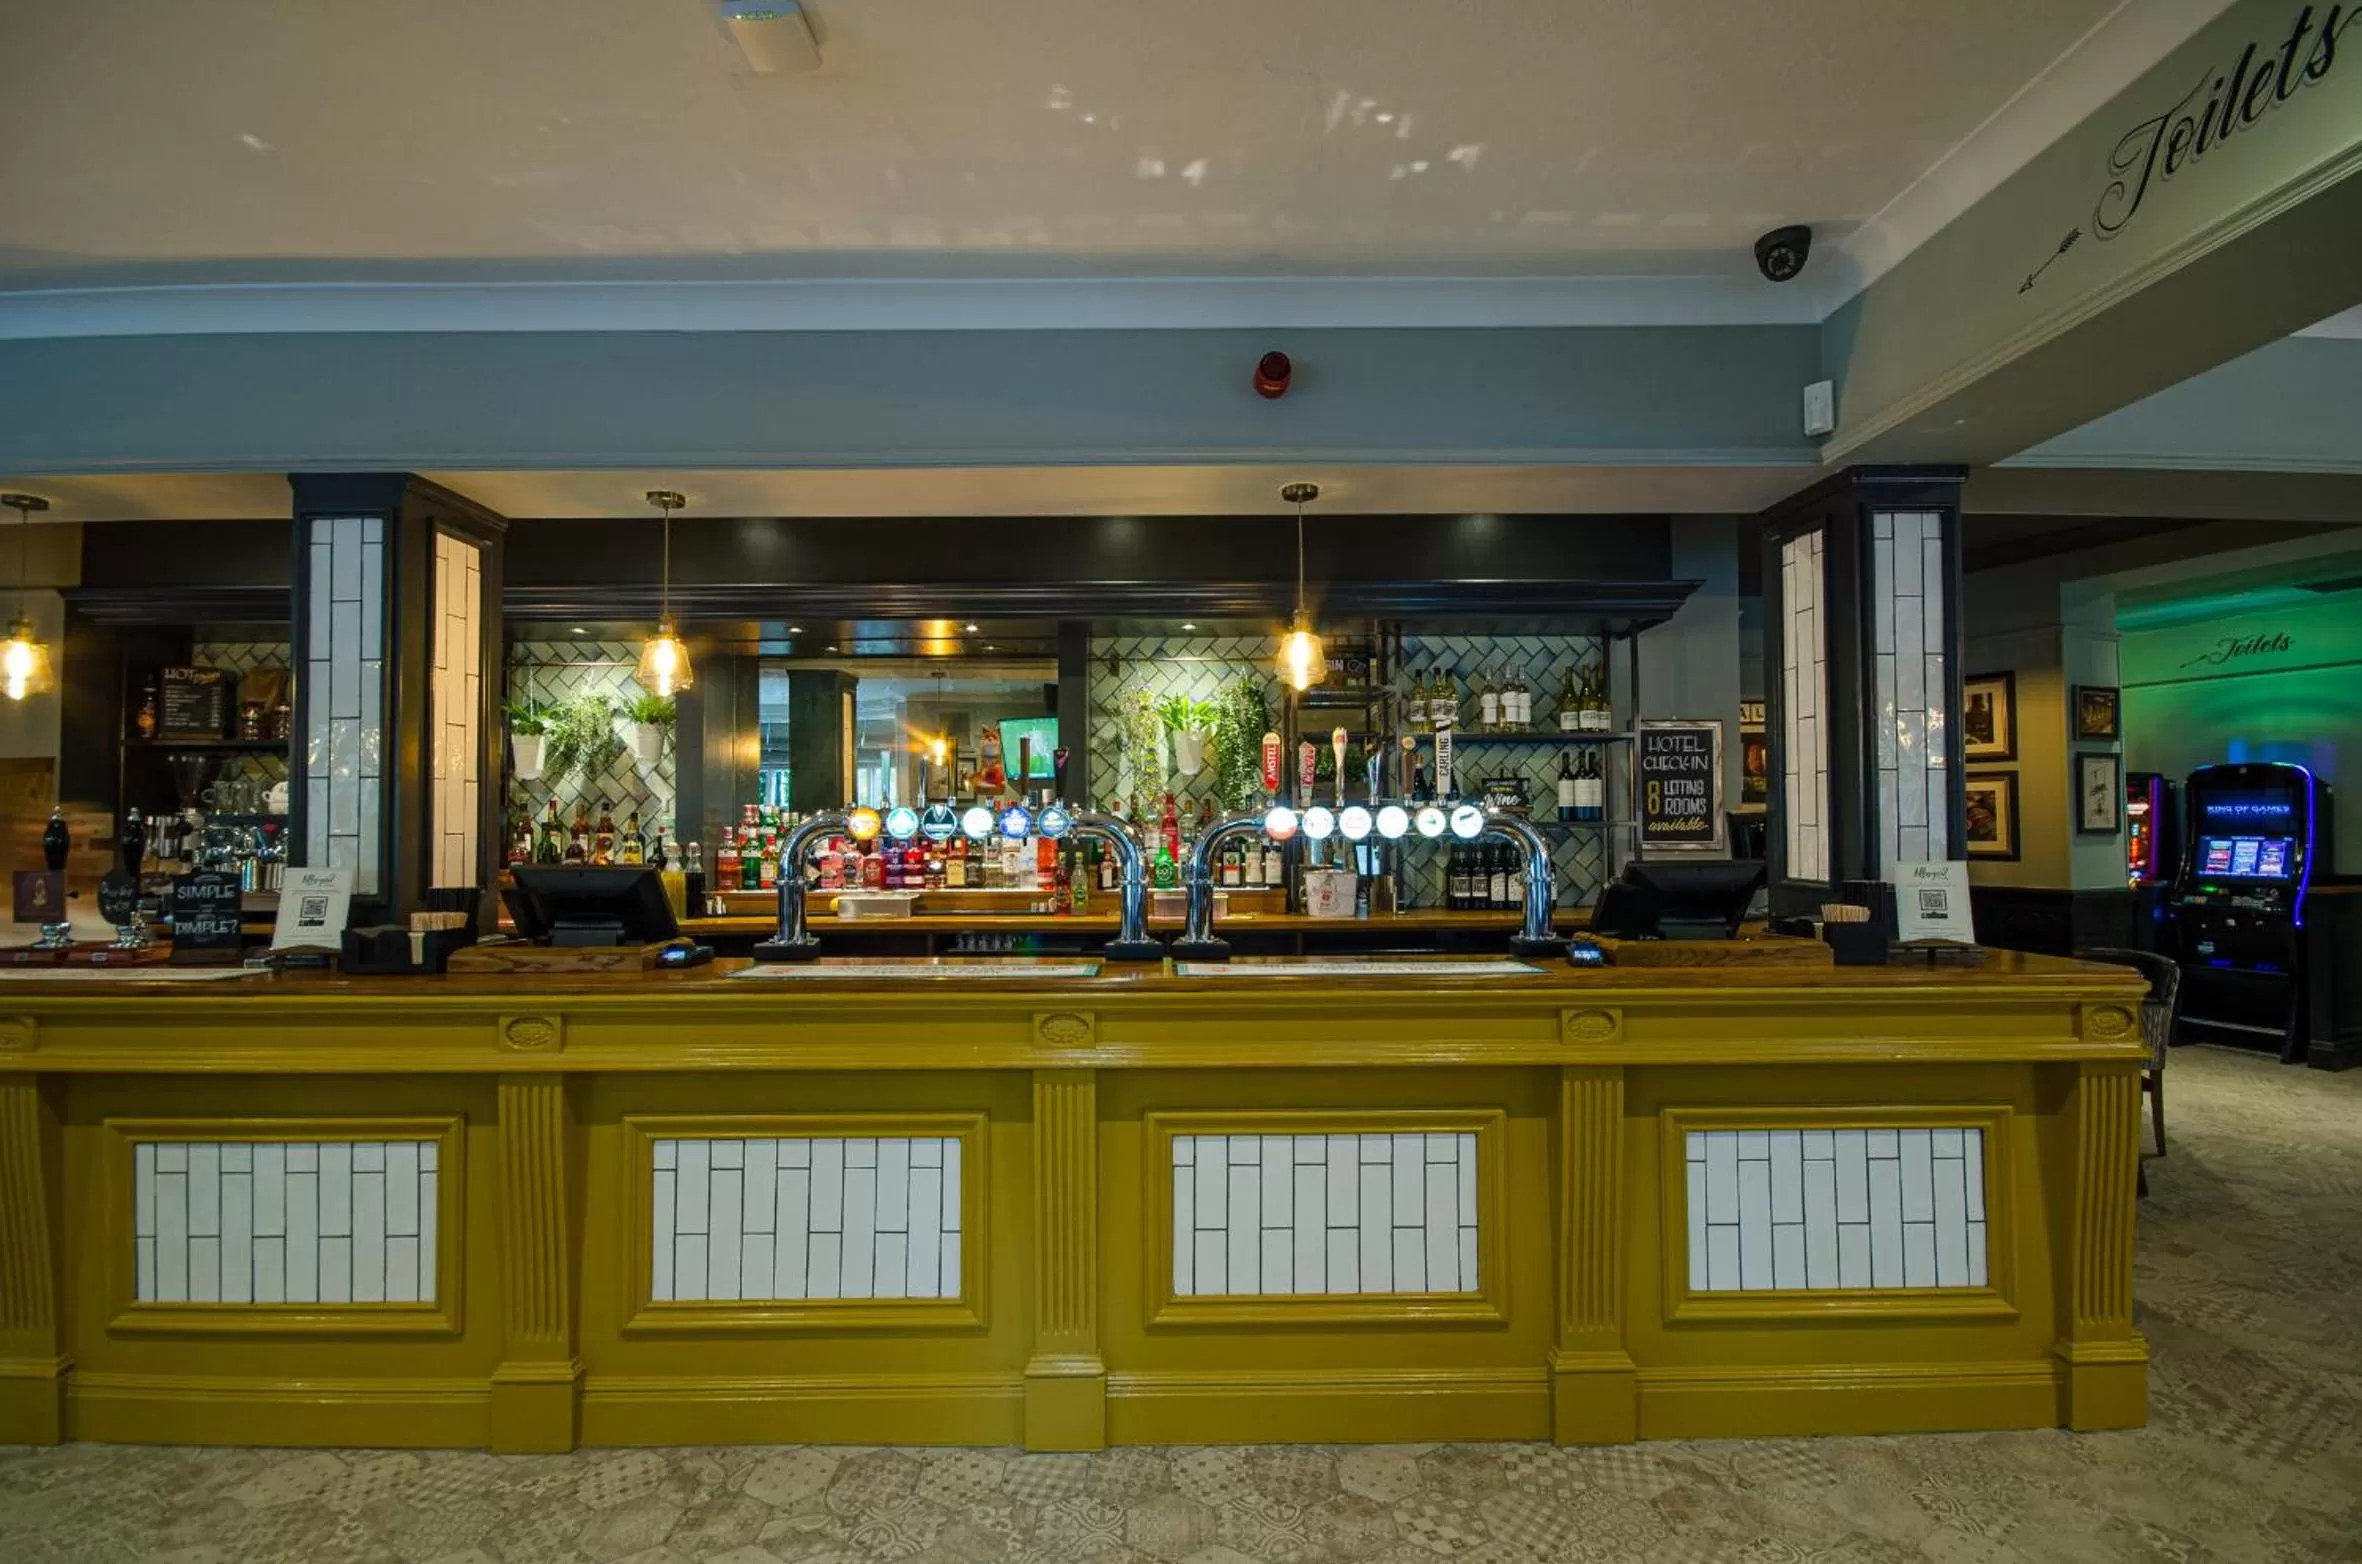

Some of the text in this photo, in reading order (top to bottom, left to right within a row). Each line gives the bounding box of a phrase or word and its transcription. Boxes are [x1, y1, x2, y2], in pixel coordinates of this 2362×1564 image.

[2096, 4, 2362, 233] Toilets
[2208, 632, 2296, 665] Toilets
[1647, 735, 1706, 752] HOTEL
[1267, 744, 1278, 781] AMSTEL
[1439, 738, 1449, 776] CARLING
[1647, 780, 1661, 815] 8
[1664, 798, 1707, 815] ROOMS
[1647, 817, 1710, 832] available
[177, 884, 236, 900] SIMPLE
[175, 919, 239, 936] DIMPLE?
